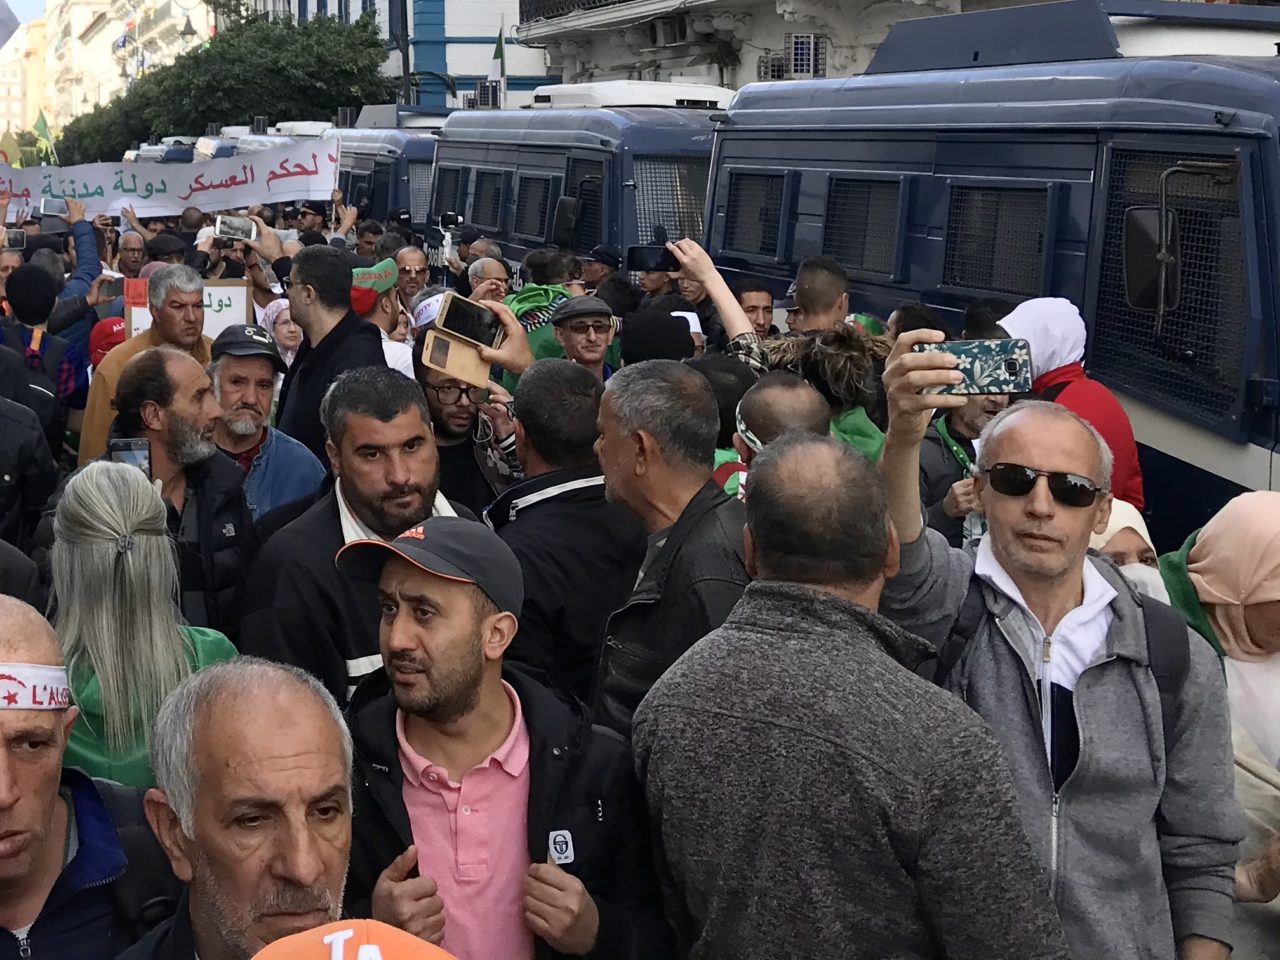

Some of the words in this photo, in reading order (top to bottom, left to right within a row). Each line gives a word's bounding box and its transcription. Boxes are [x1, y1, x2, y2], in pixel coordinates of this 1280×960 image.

[113, 170, 168, 200] دولة
[177, 163, 255, 201] العسكر
[266, 153, 319, 192] لحكم
[203, 292, 232, 313] دول
[32, 684, 70, 707] L'ALG
